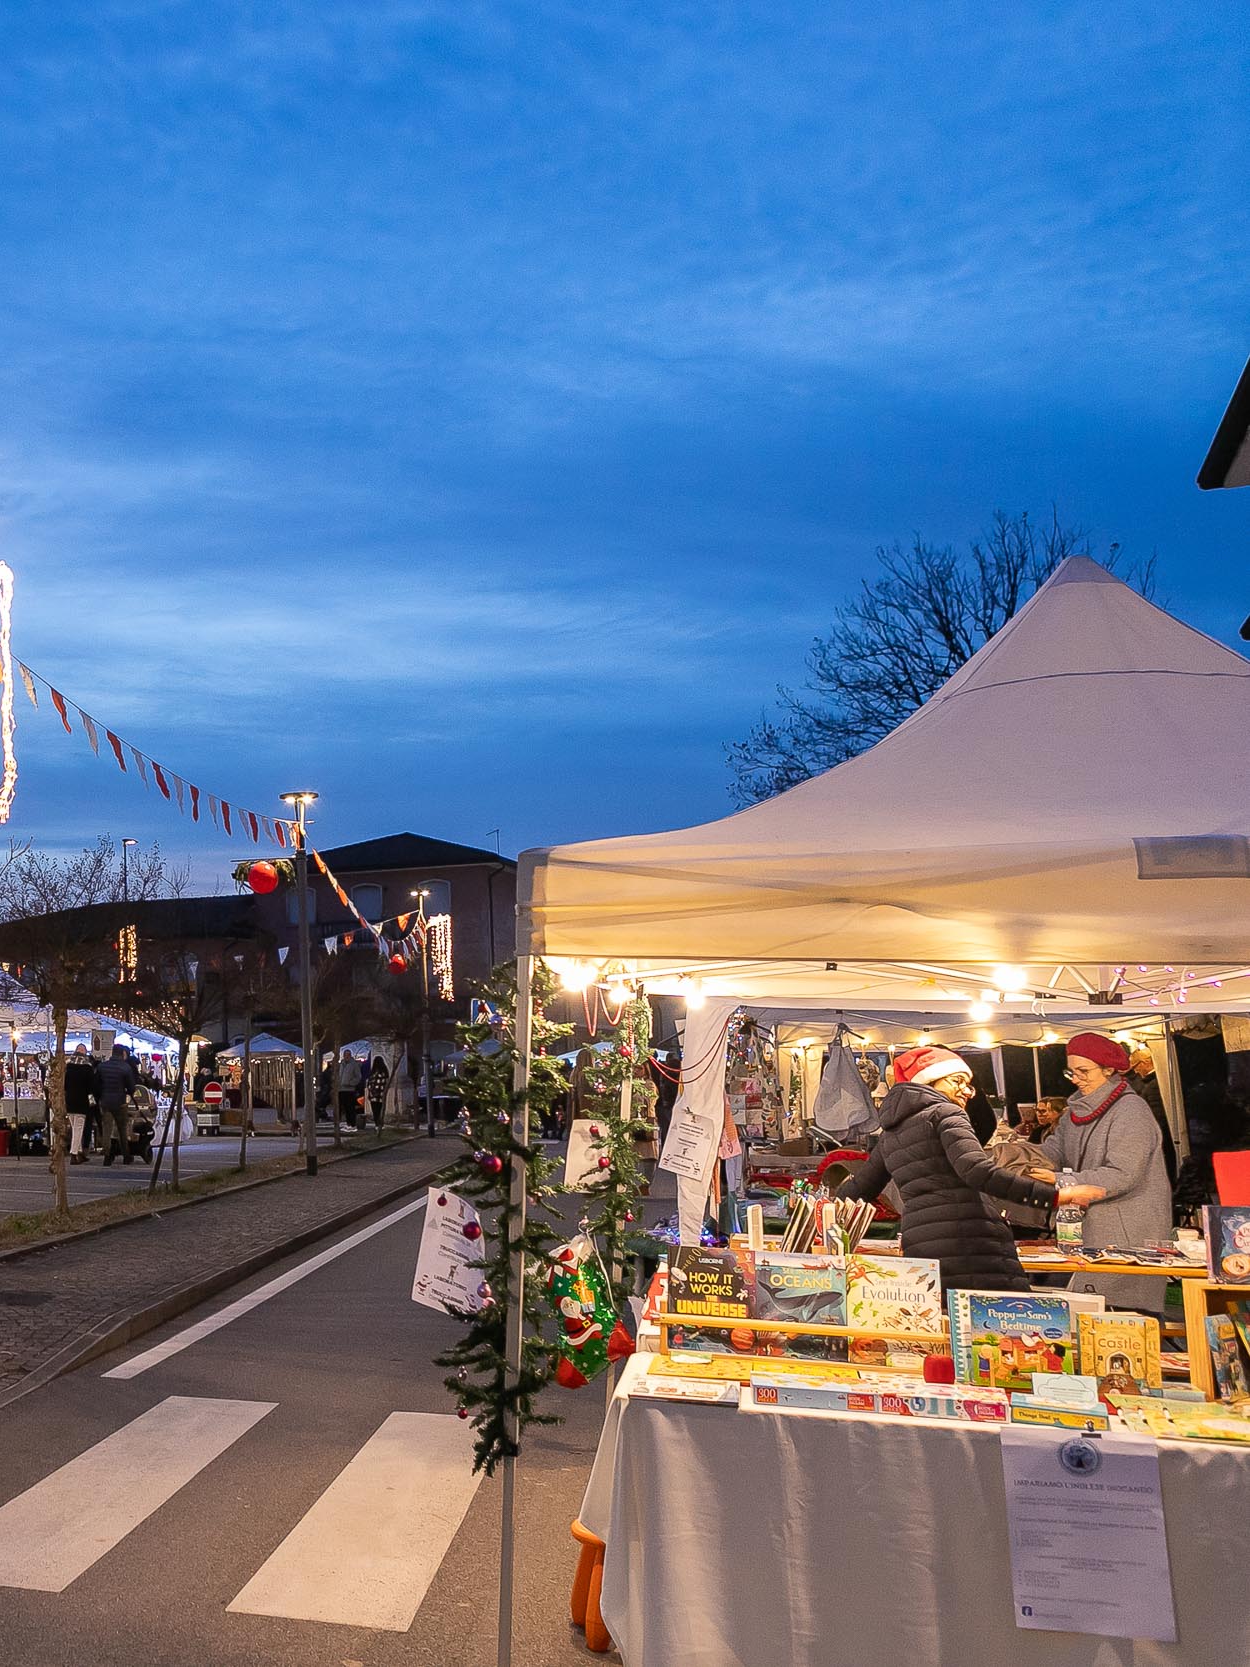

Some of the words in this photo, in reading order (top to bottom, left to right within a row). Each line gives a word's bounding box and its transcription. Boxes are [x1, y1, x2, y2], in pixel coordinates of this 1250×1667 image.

[698, 1257, 724, 1265] USBORNE
[689, 1272, 721, 1284] HOW
[724, 1274, 734, 1285] IT
[770, 1274, 833, 1290] OCEANS
[689, 1283, 733, 1296] WORKS
[862, 1287, 926, 1303] Evolution
[676, 1300, 747, 1318] UNIVERSE
[987, 1308, 1016, 1321] Poppy
[1027, 1310, 1053, 1320] Sam's
[1000, 1320, 1042, 1331] Bedtime
[758, 1388, 776, 1398] 300
[883, 1396, 902, 1408] 300
[1013, 1479, 1064, 1489] IMPARIAMO
